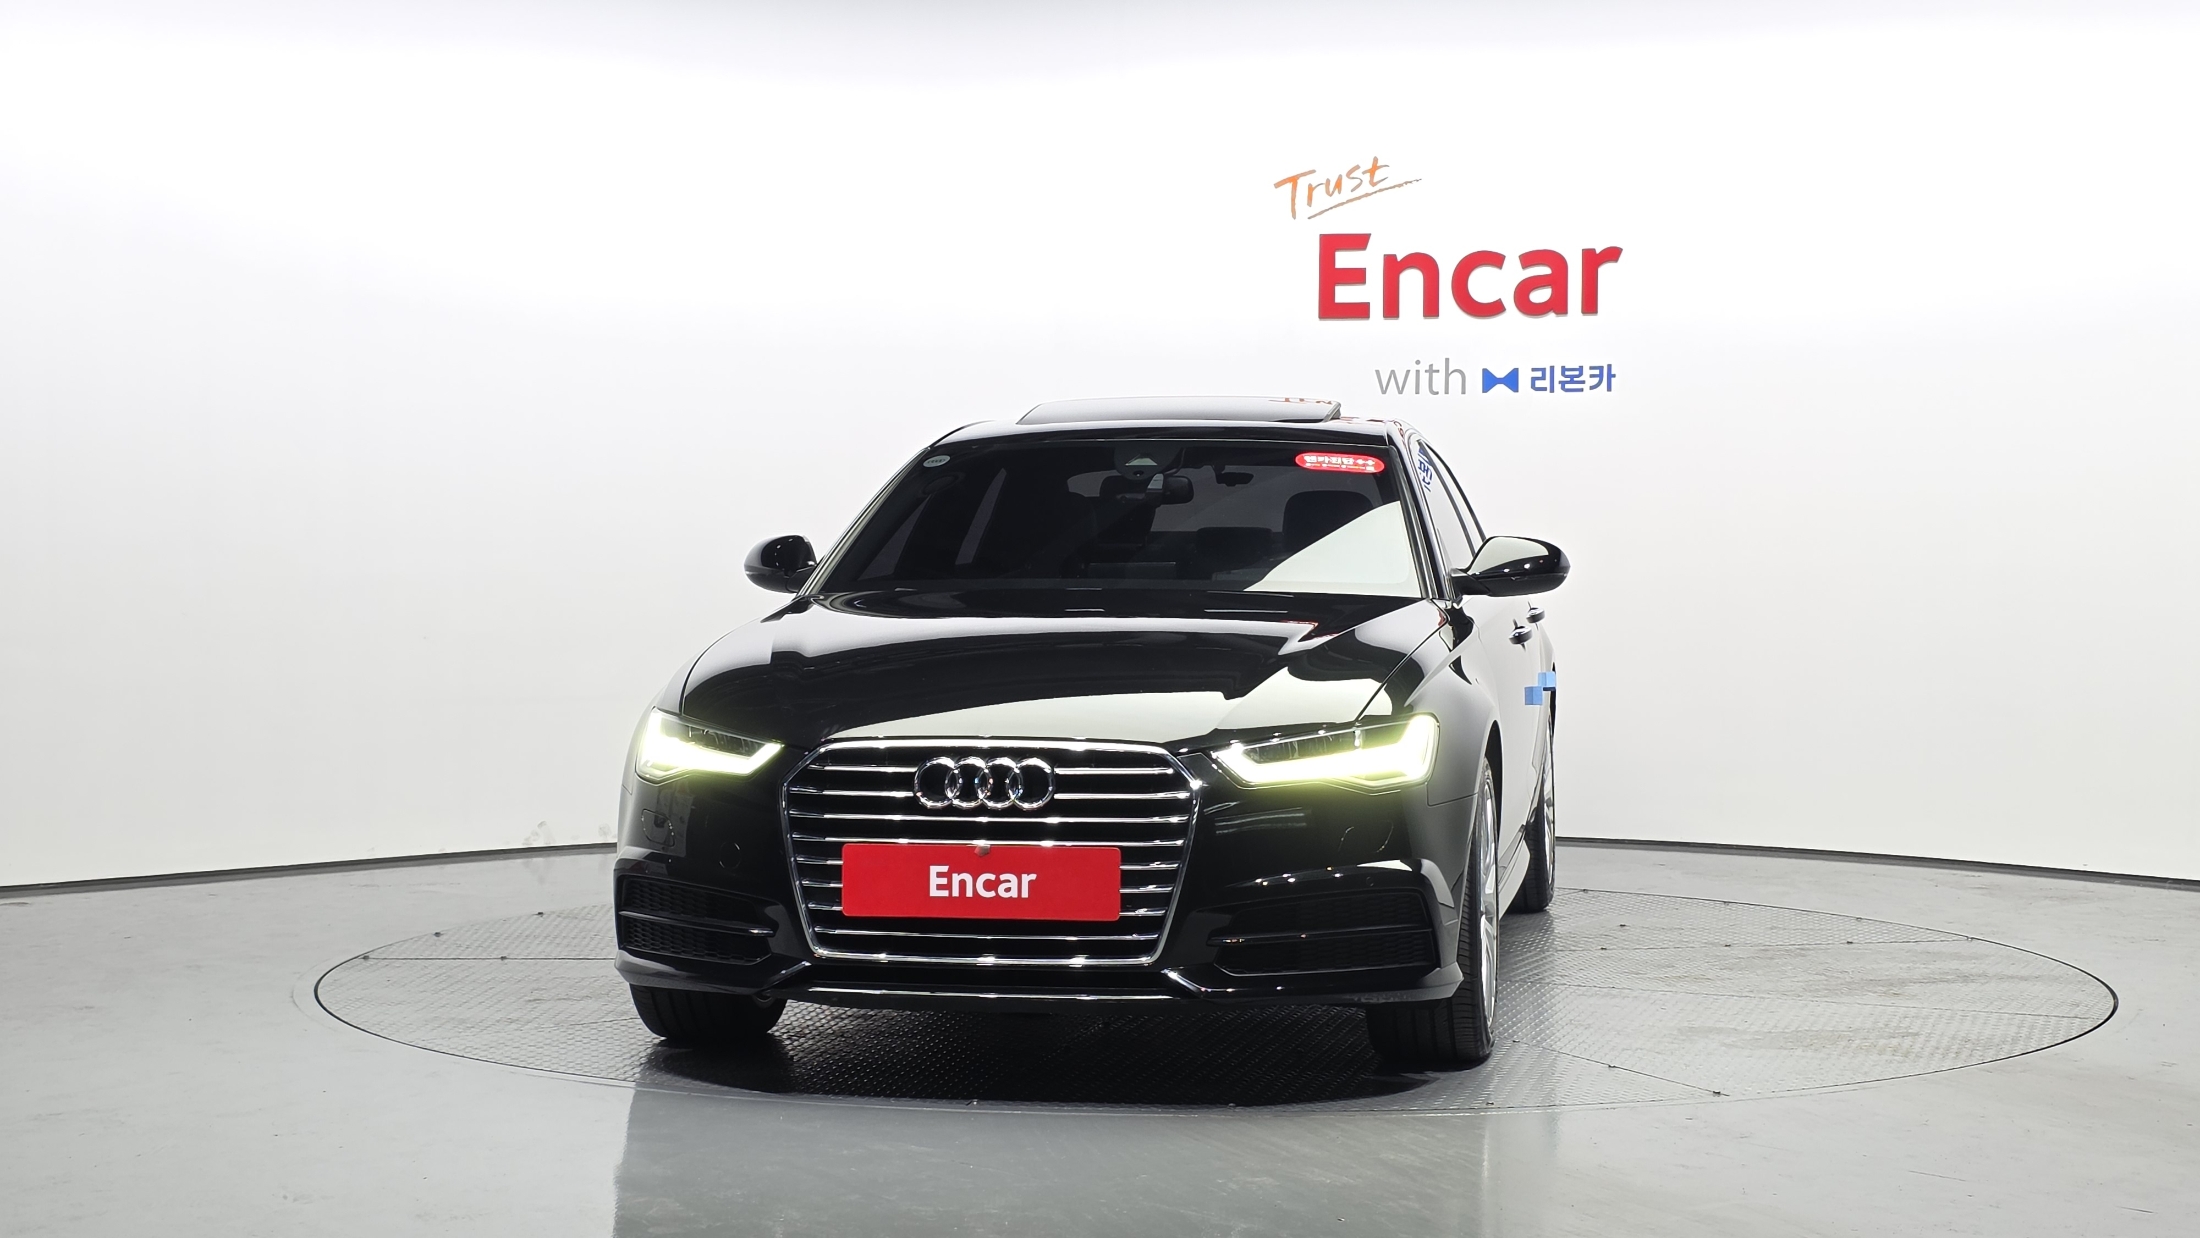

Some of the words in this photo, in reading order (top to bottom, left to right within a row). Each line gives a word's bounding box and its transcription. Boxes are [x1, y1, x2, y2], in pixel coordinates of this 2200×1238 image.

[1274, 156, 1391, 219] Trust
[1318, 233, 1623, 319] Encar
[1375, 358, 1467, 395] with
[1531, 364, 1616, 393] 리본카
[929, 865, 1037, 899] Encar
